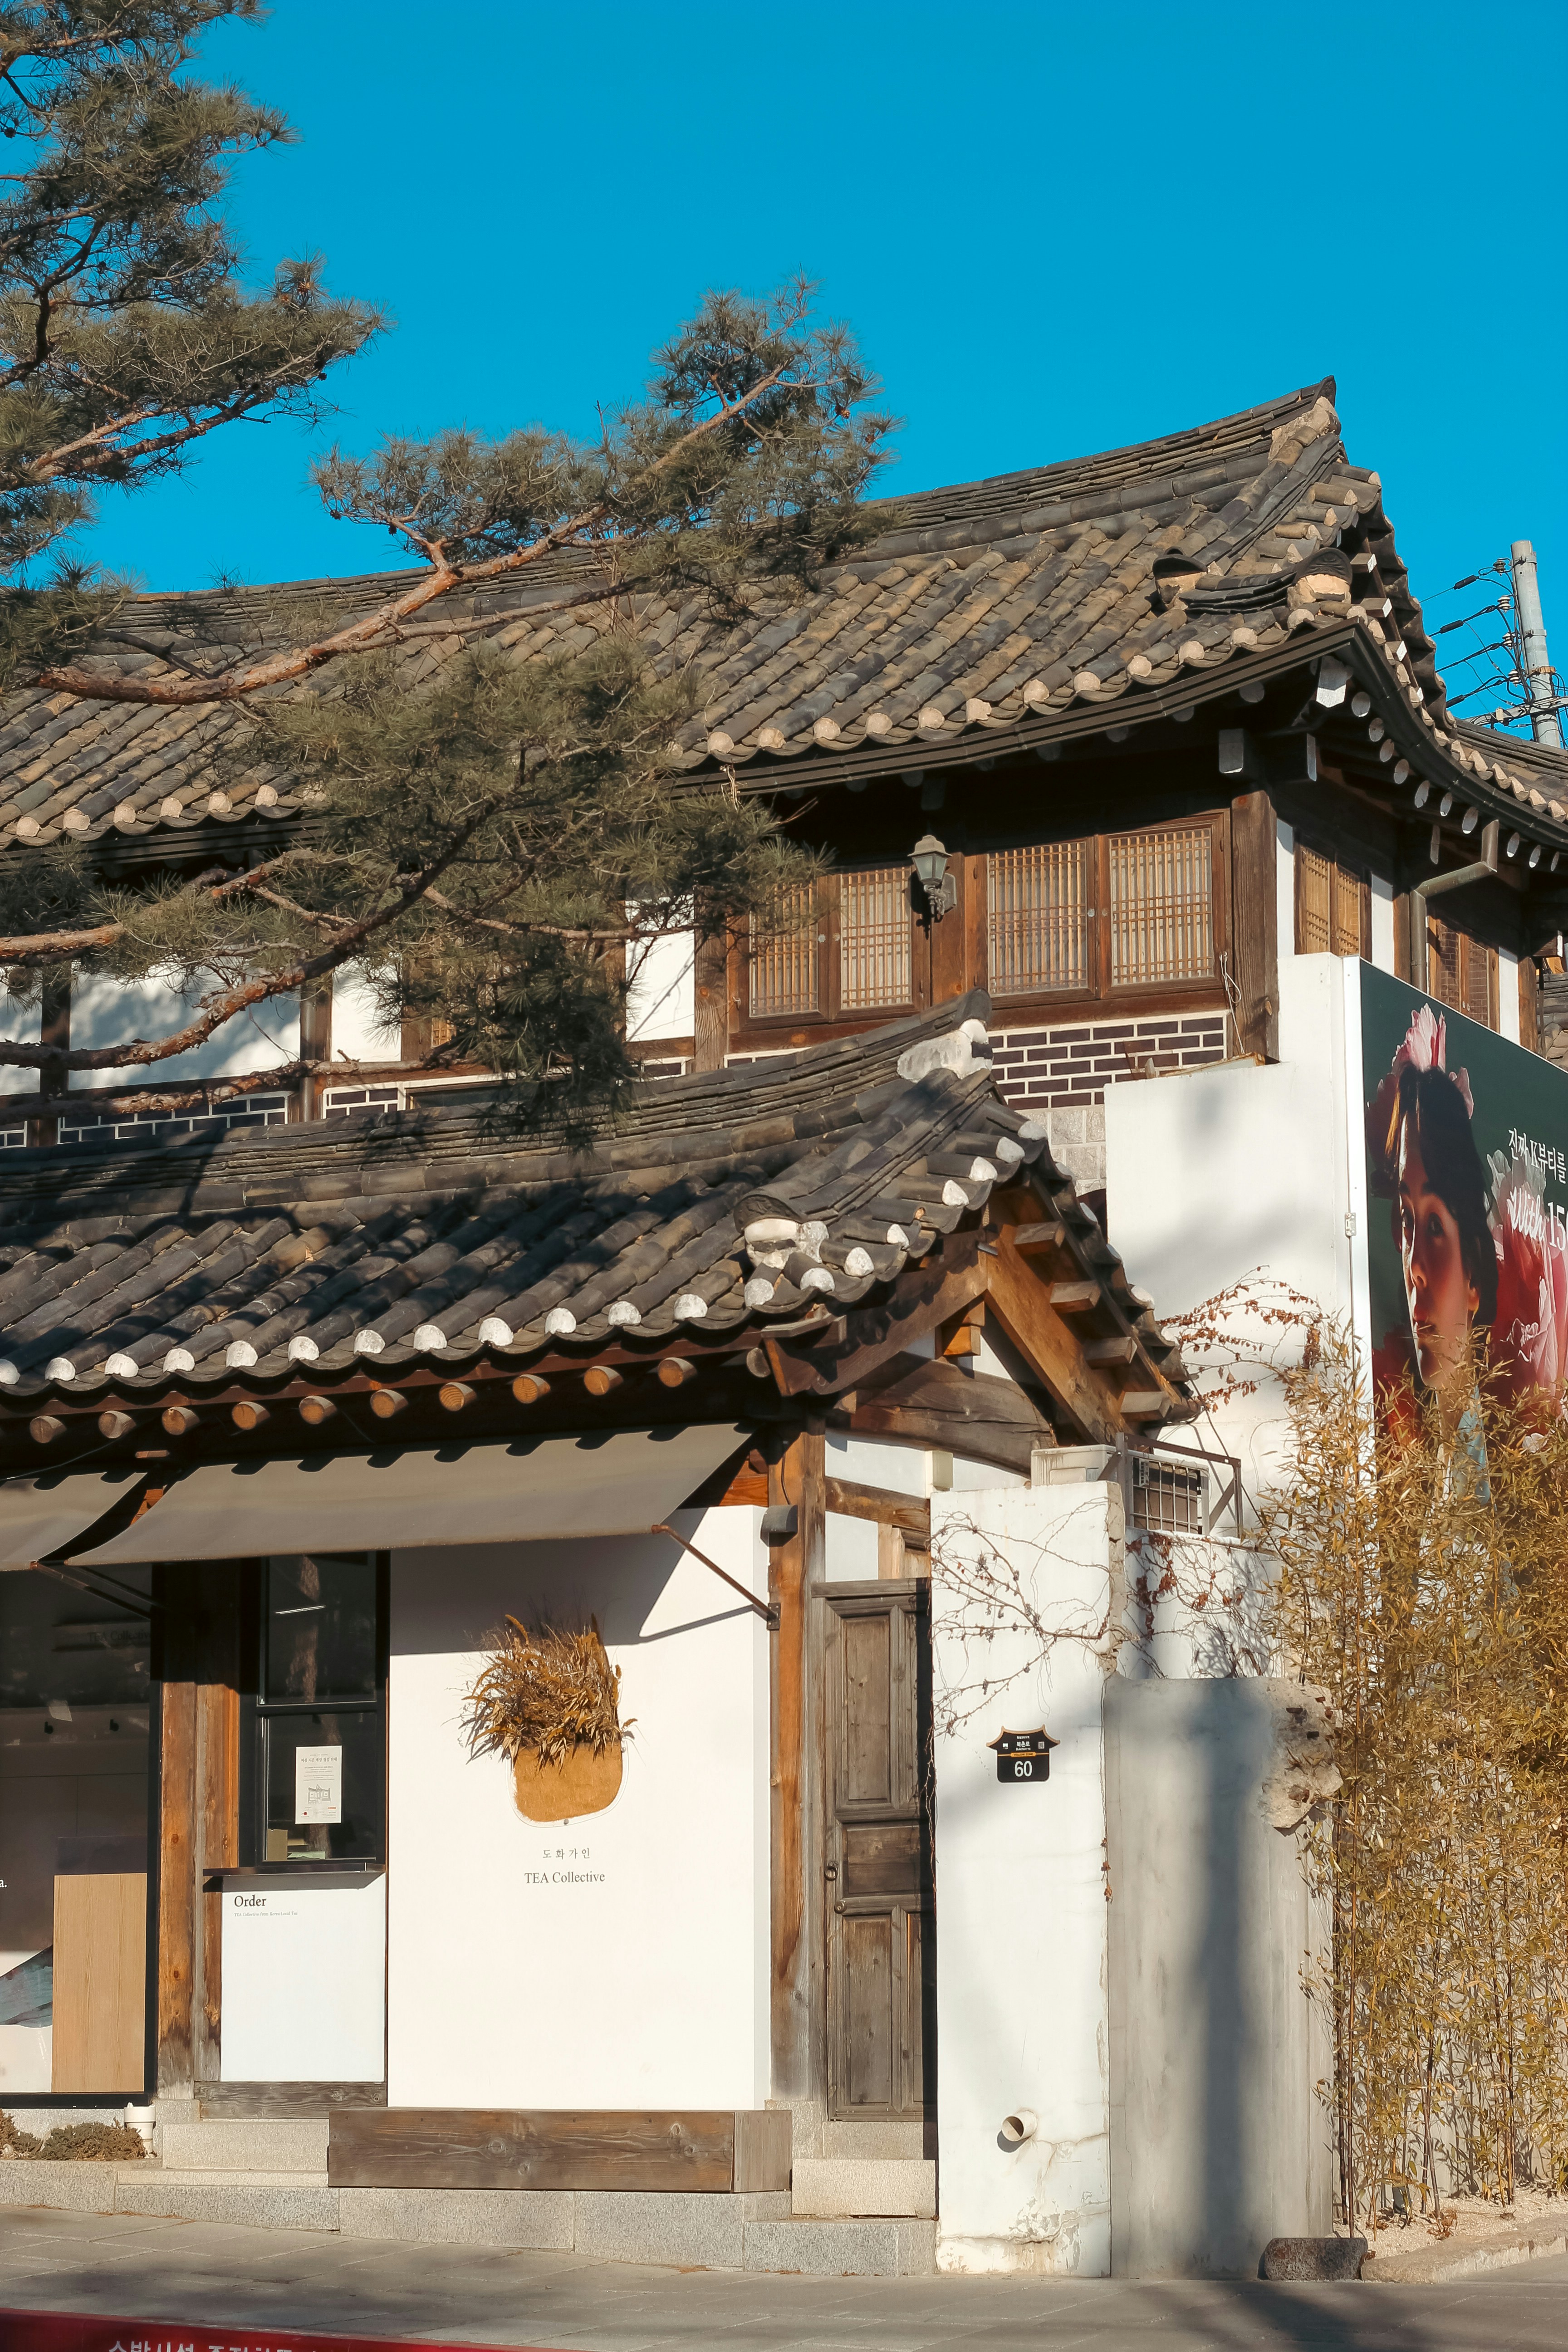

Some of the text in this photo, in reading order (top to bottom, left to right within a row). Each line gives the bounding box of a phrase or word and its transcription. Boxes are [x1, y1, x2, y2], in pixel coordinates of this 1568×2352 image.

[1509, 1127, 1567, 1184] 진짜 K뷰티를
[1506, 1186, 1568, 1251] With 15
[1014, 1760, 1032, 1777] 60
[524, 1871, 605, 1884] TEA Collective
[234, 1894, 267, 1907] Order
